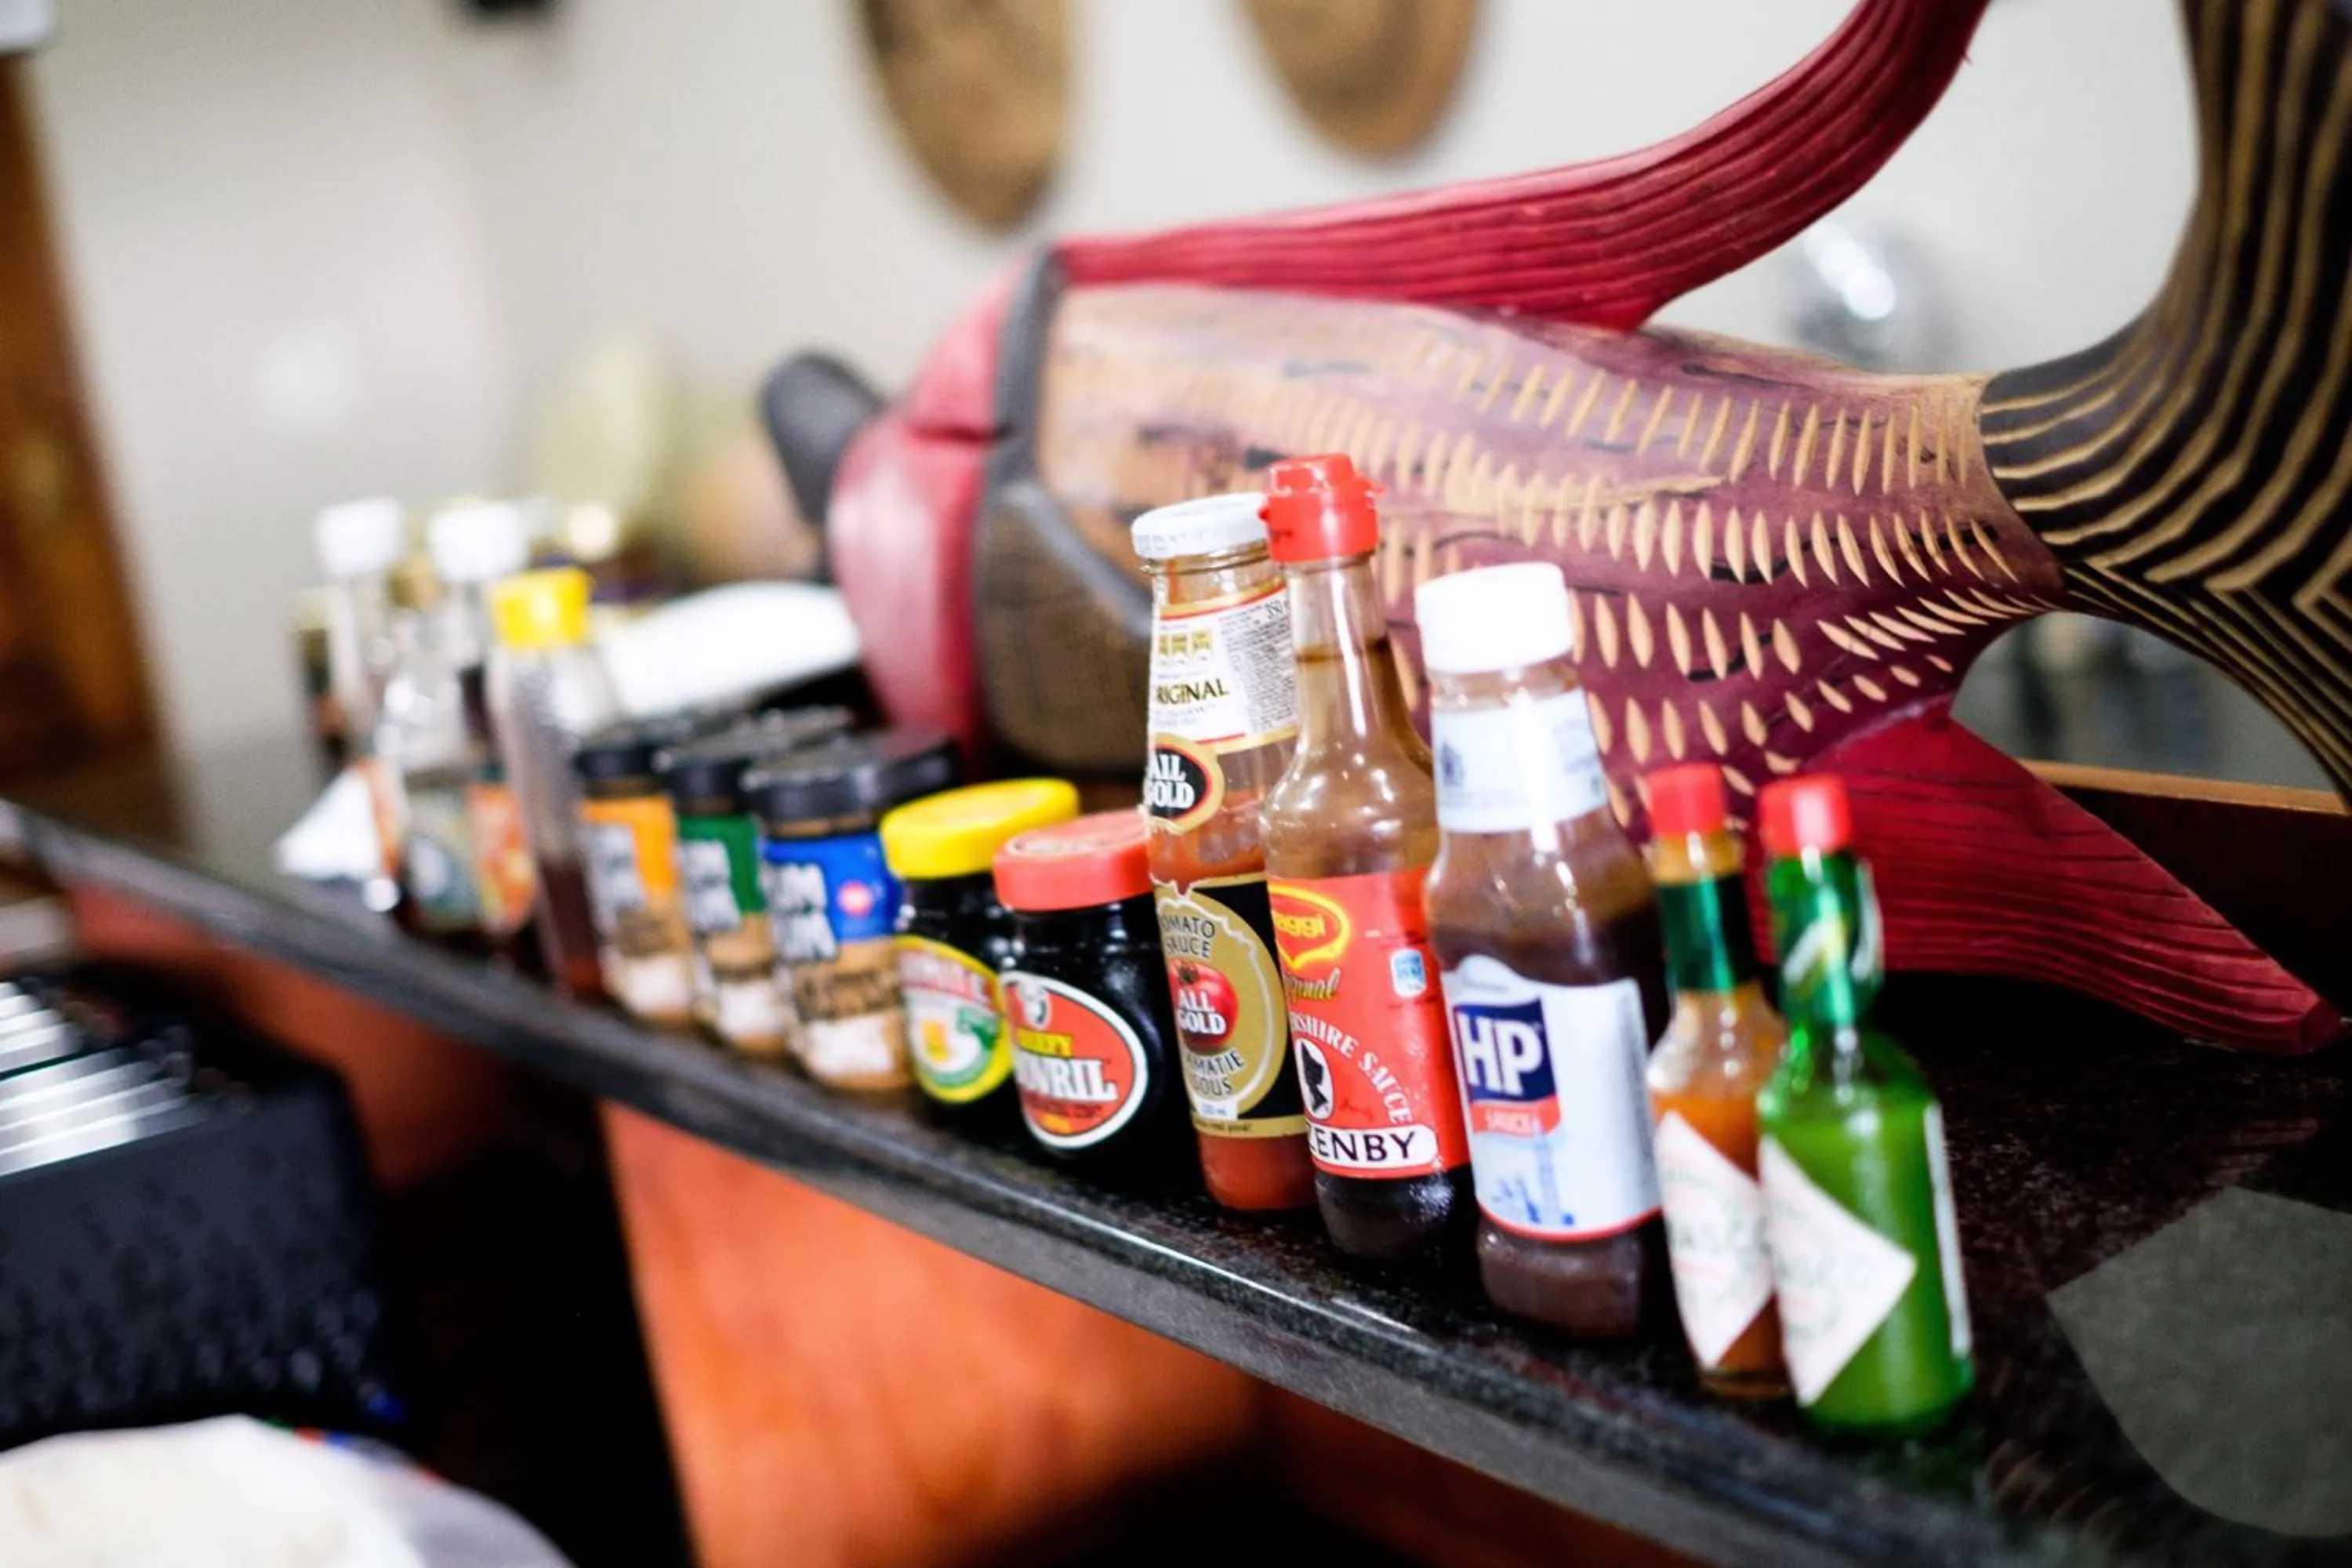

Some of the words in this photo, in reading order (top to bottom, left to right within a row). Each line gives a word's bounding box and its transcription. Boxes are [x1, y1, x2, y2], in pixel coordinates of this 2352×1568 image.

[1156, 678, 1229, 704] RIGINAL
[1272, 912, 1326, 939] aggi
[1457, 1011, 1544, 1097] HP
[1357, 1051, 1414, 1125] SAUCE
[1305, 1121, 1415, 1162] ENBY
